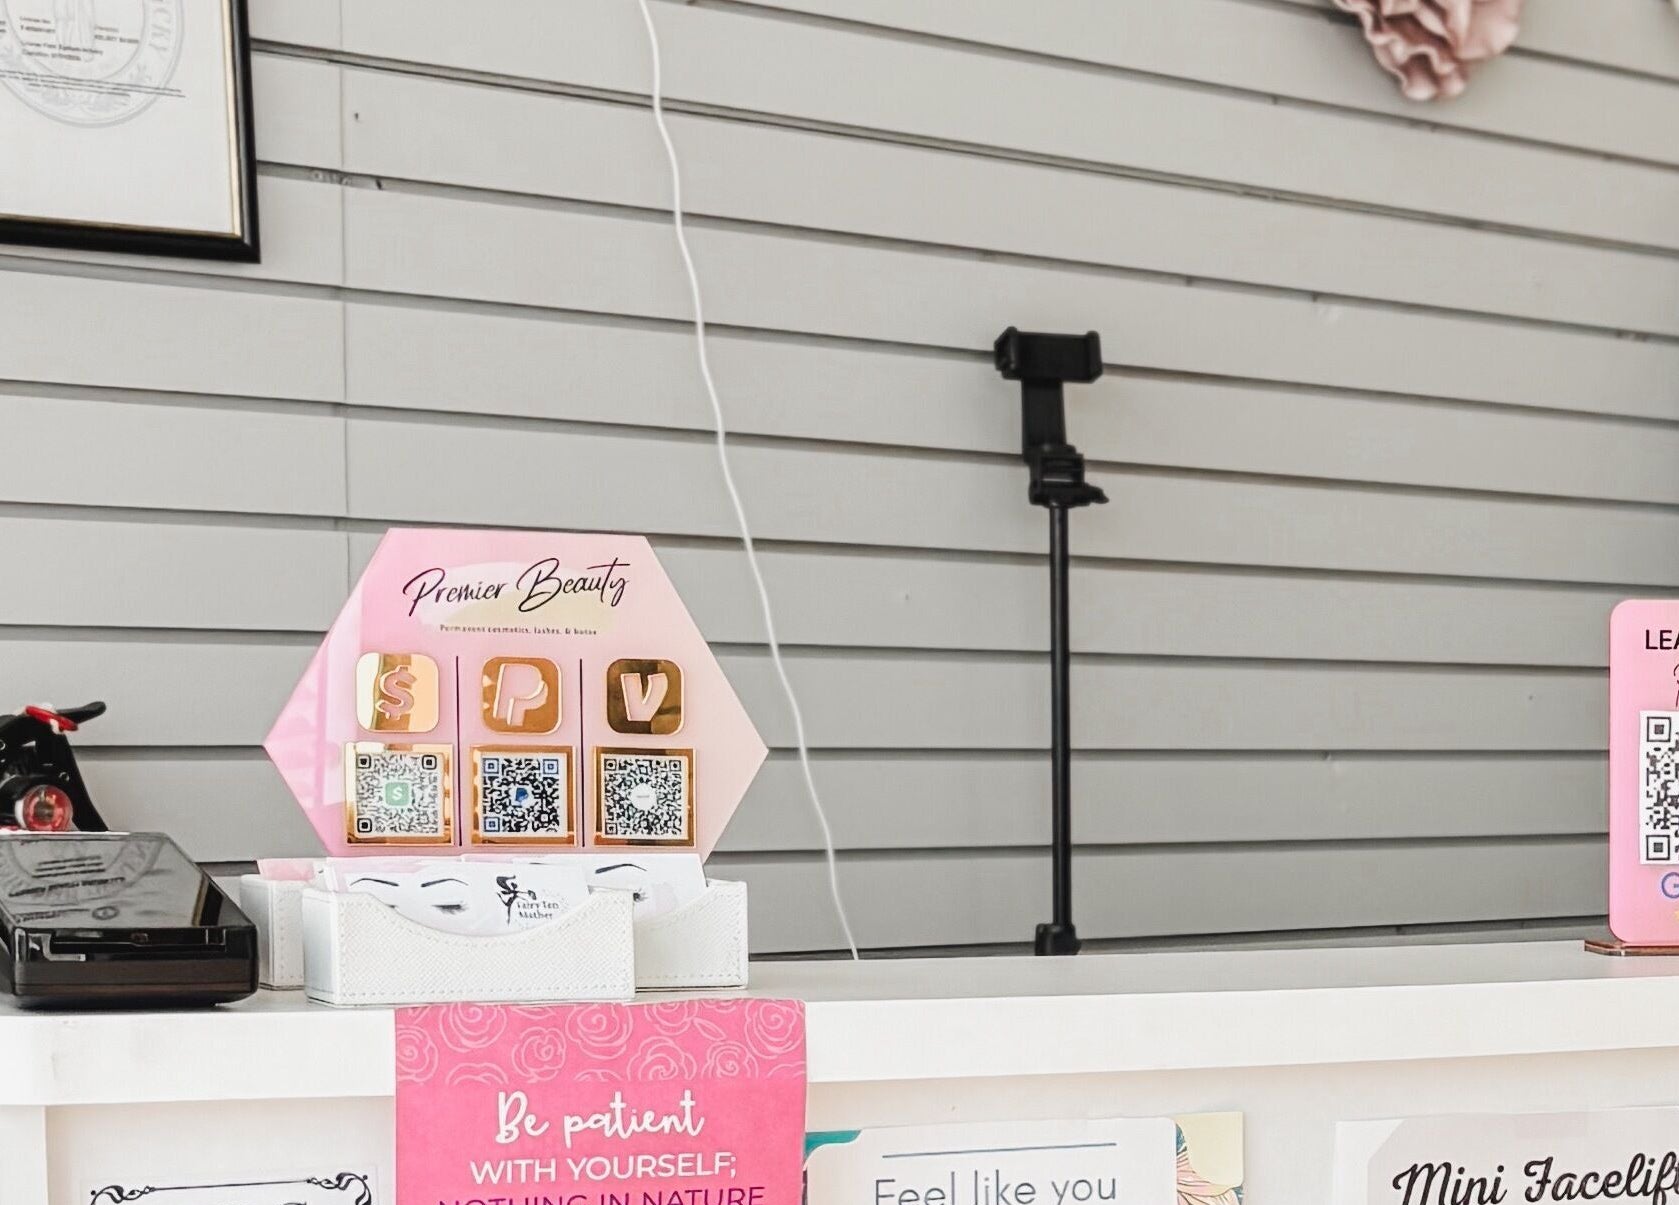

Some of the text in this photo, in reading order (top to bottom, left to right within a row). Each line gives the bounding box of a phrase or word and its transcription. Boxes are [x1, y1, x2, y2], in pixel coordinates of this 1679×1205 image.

[402, 557, 631, 617] Premier Beauty
[495, 1089, 705, 1149] Be patient
[470, 1151, 738, 1185] WITH YOURSELF;
